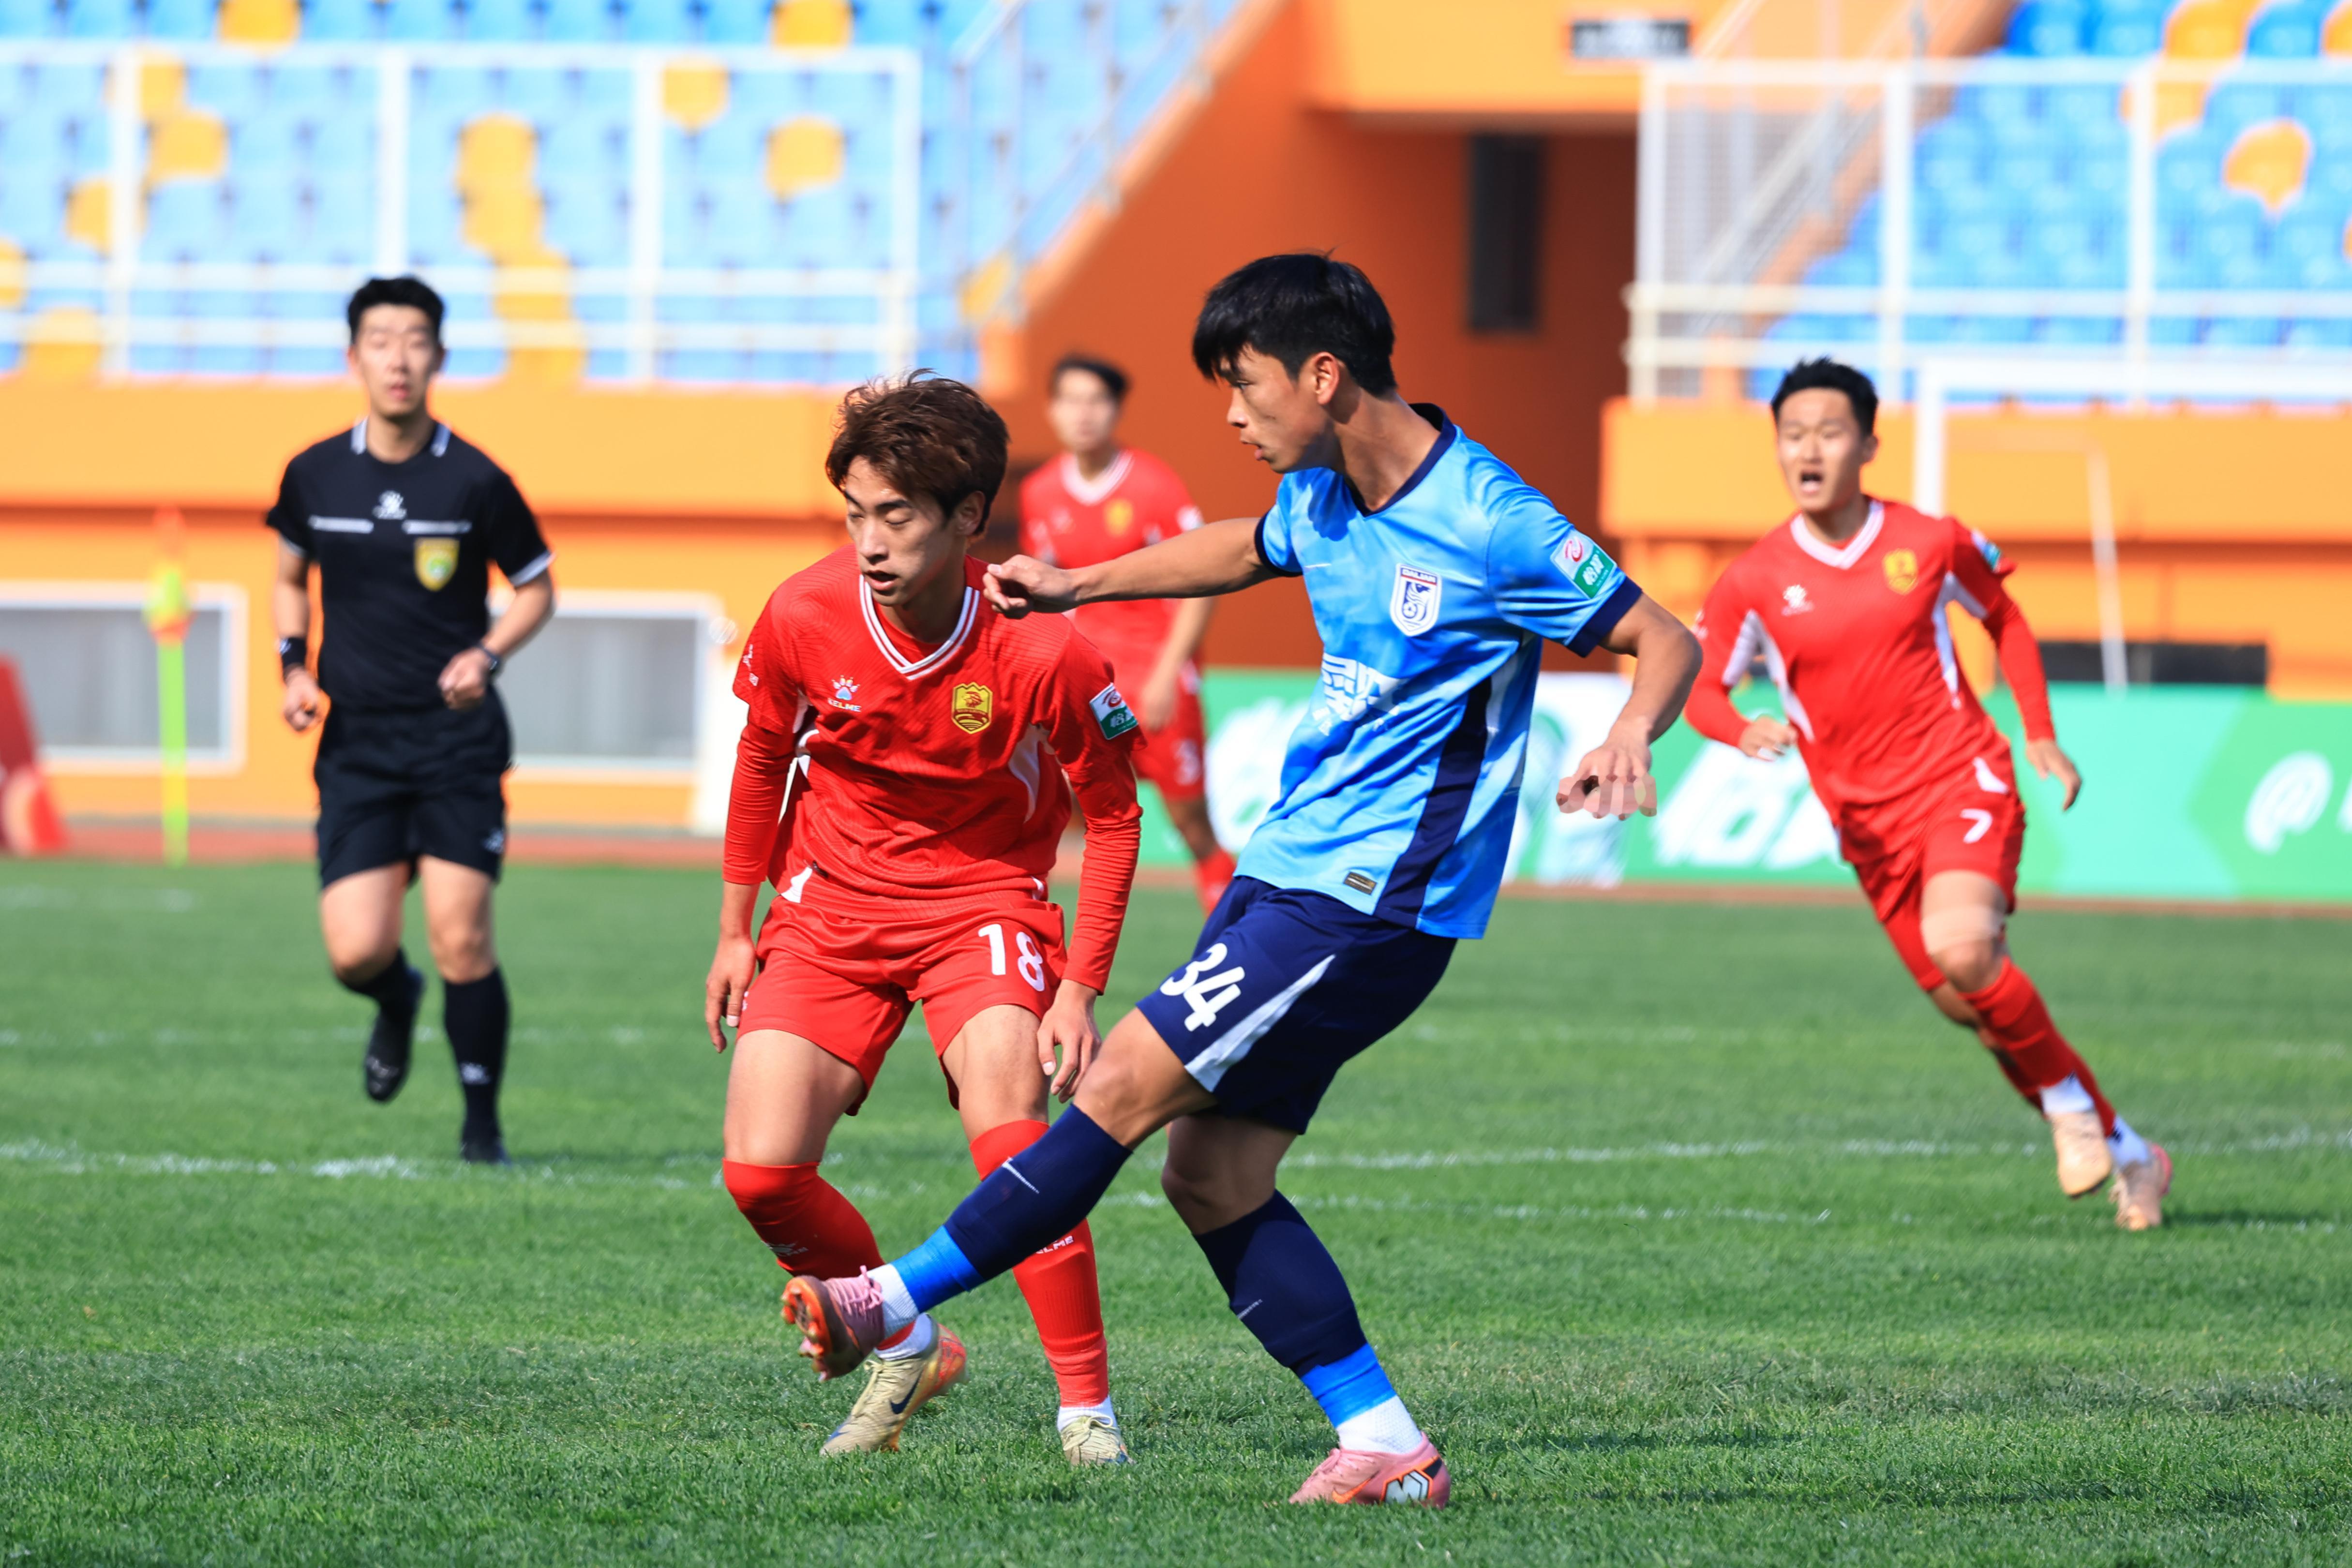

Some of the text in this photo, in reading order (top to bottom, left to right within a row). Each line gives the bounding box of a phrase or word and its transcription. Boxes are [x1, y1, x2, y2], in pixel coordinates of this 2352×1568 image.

[1960, 808, 1992, 844] 7
[978, 923, 1045, 991] 18
[1160, 942, 1245, 1032] 34
